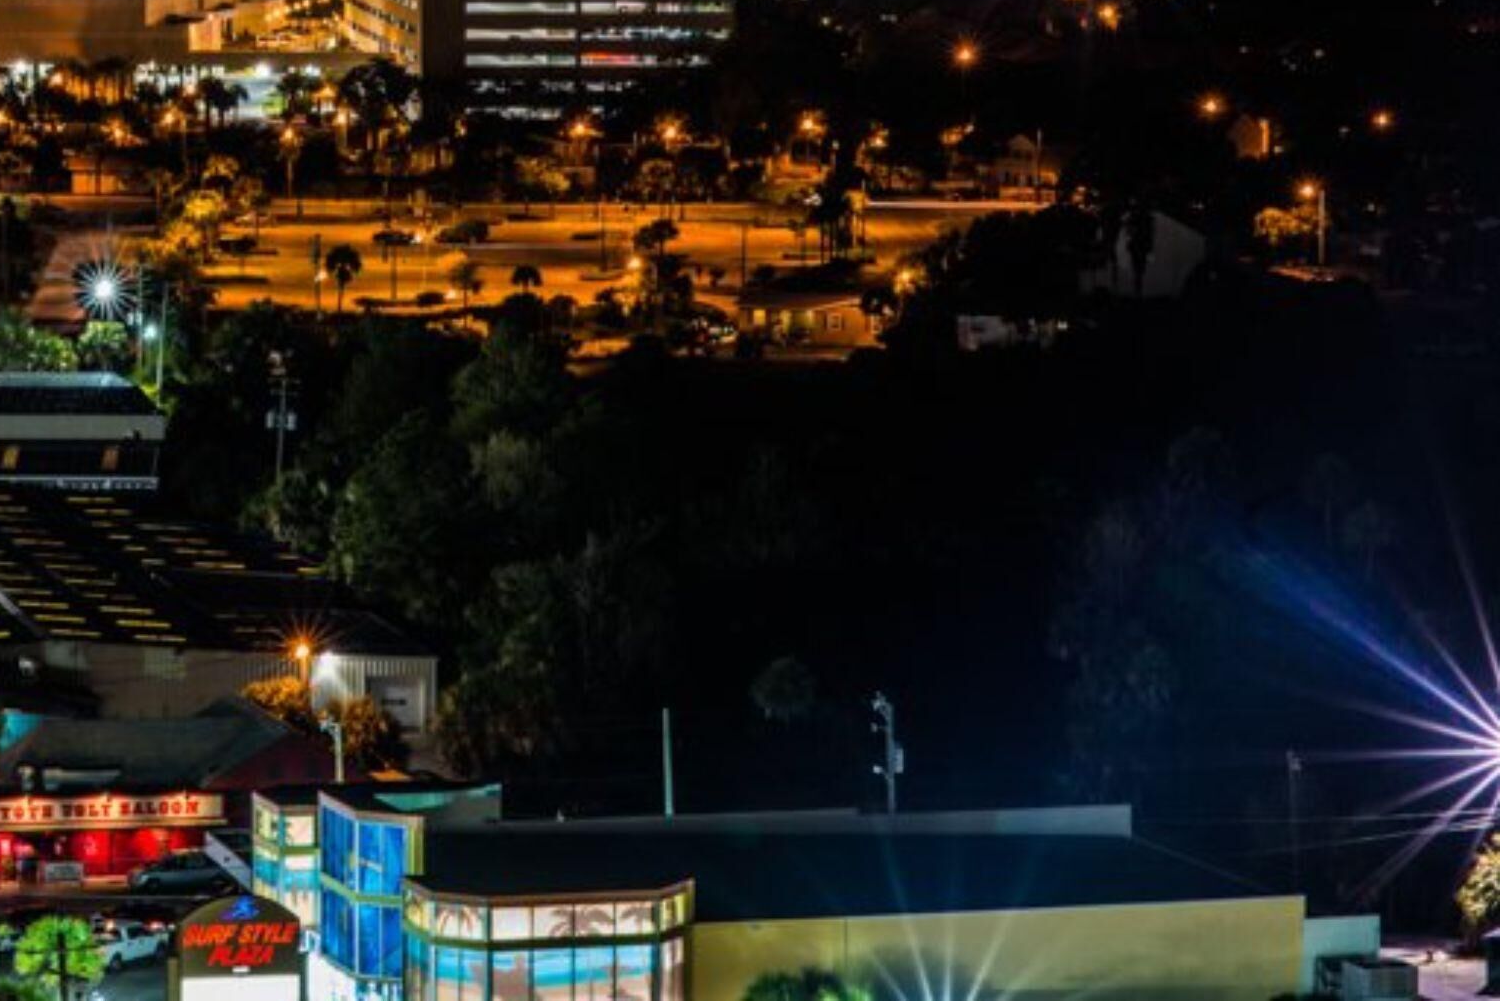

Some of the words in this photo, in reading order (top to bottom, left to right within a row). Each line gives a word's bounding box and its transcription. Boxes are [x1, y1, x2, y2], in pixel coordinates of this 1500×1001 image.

[119, 800, 200, 816] SALOON
[183, 922, 236, 948] SURF
[237, 922, 297, 944] STYLE
[207, 944, 274, 967] PLAZA
